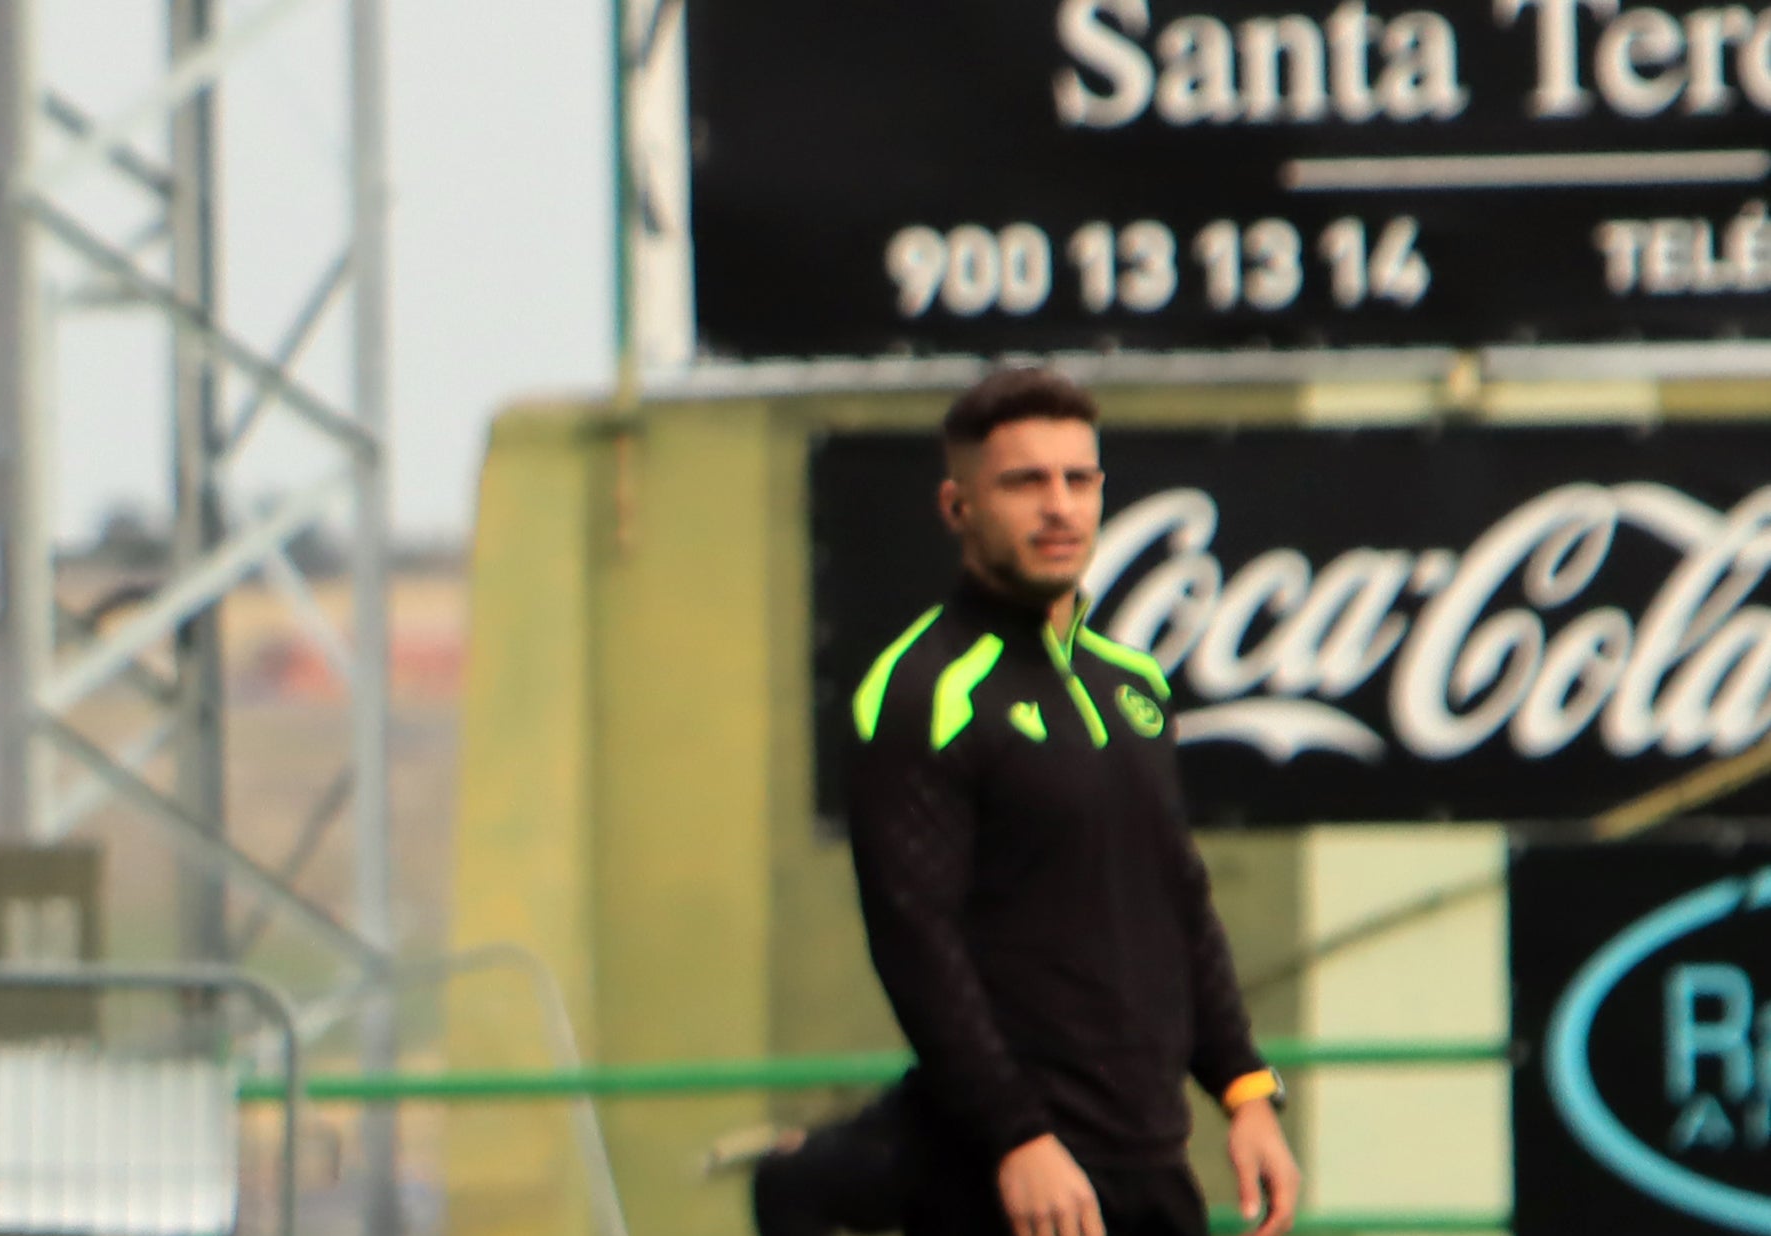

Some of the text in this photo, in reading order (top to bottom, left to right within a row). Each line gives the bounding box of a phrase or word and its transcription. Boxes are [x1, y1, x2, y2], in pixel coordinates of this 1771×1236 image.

[1053, 0, 1466, 127] Santa
[886, 214, 1431, 317] 900 13 13 14
